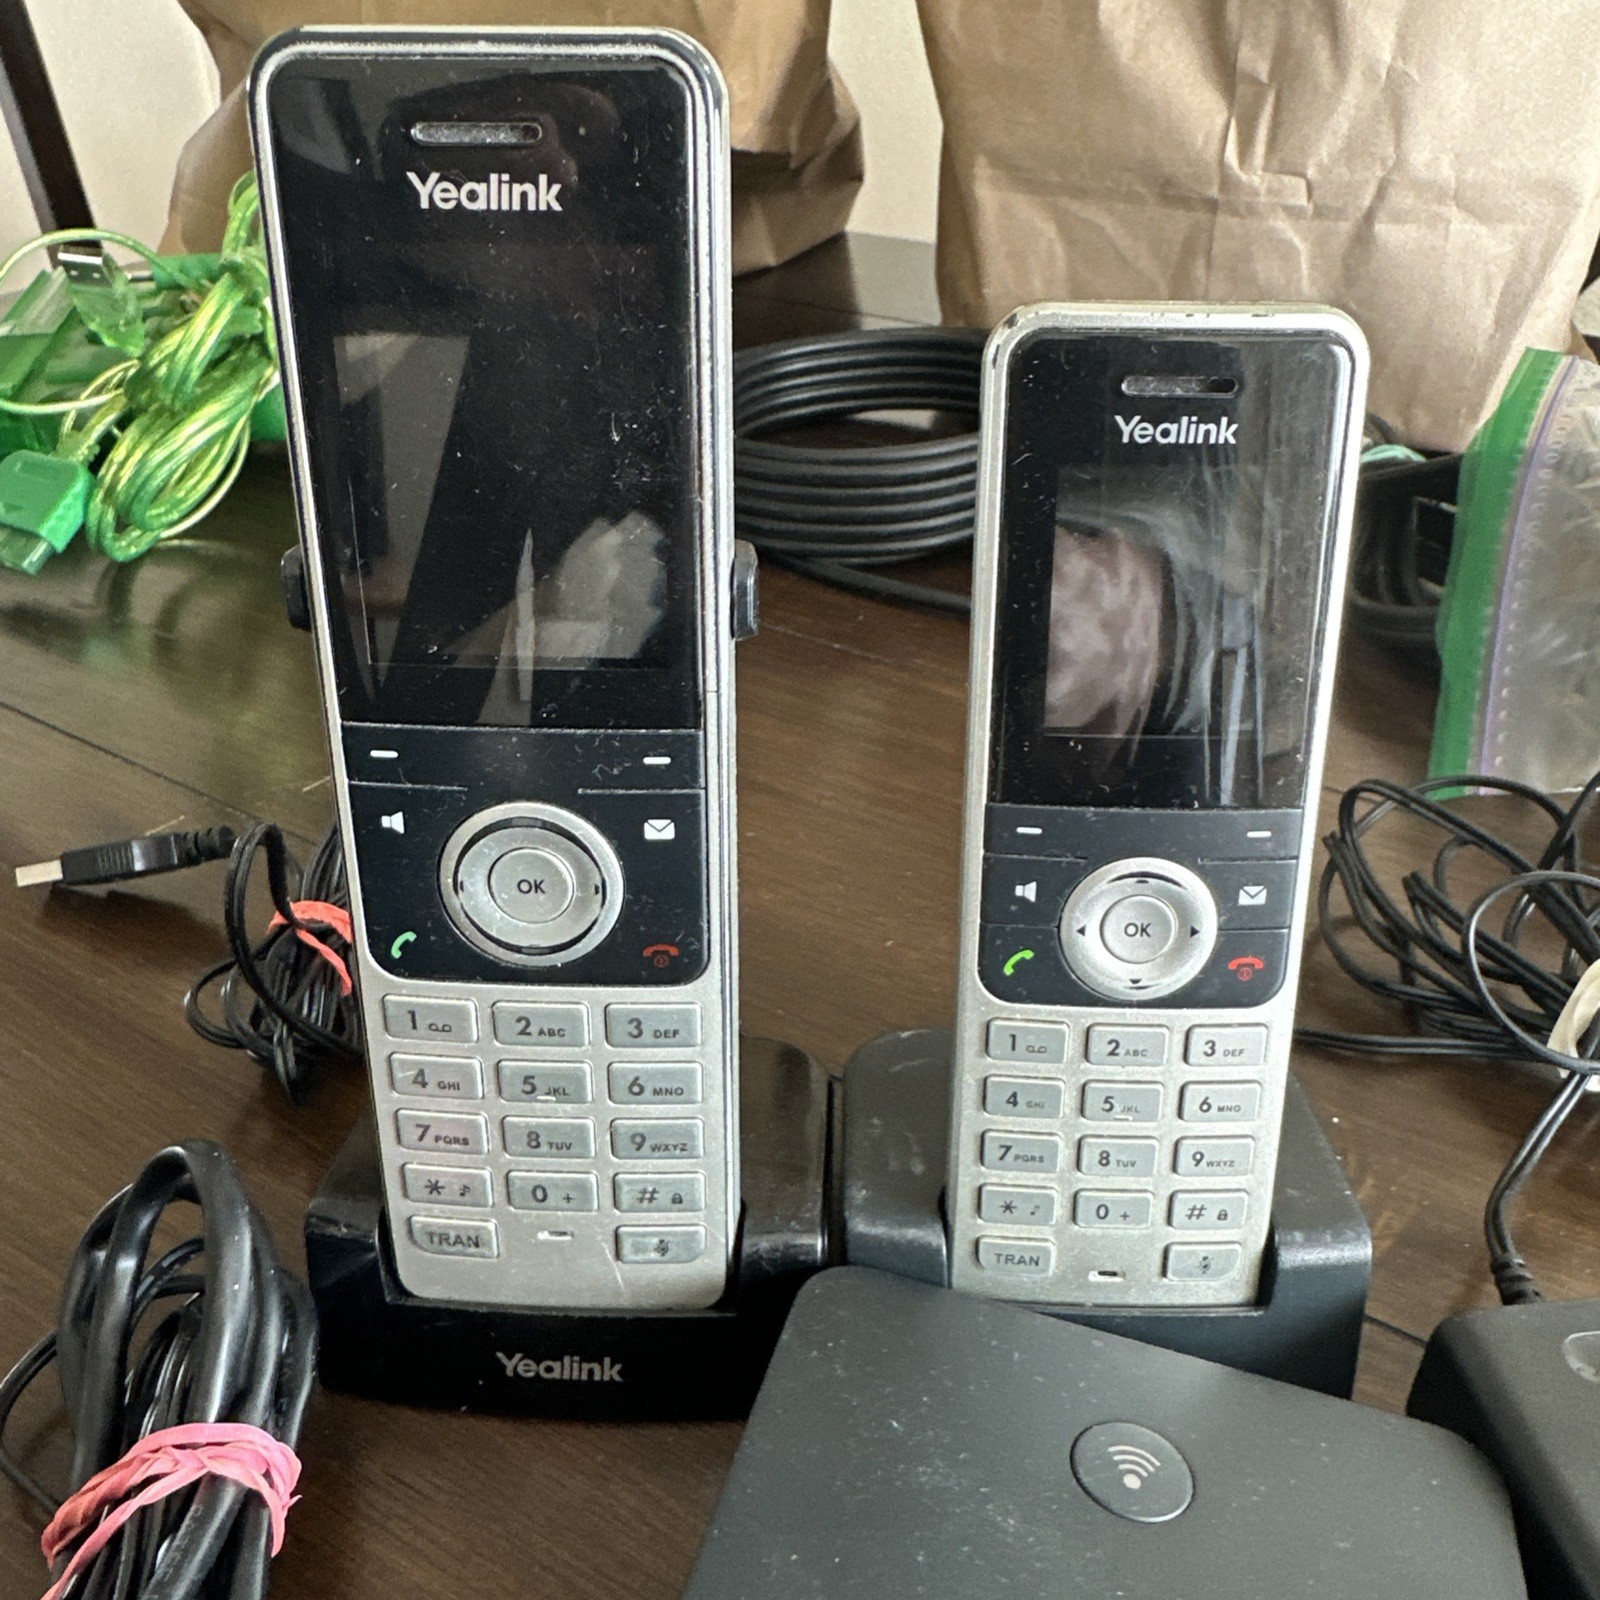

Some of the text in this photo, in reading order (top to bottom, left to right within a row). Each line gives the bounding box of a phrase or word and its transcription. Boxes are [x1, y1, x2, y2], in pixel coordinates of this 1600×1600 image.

[406, 171, 563, 211] Yealink
[1114, 415, 1239, 444] Yealink
[517, 879, 546, 895] OK
[1123, 922, 1152, 938] OK
[408, 1010, 418, 1031] 1
[516, 1016, 566, 1038] 2 ABC
[627, 1018, 680, 1038] 3 DEF
[1009, 1034, 1016, 1051] 1
[1106, 1039, 1148, 1057] 2 ABC
[1203, 1040, 1245, 1057] 3 DEF
[412, 1069, 461, 1091] 4 GHI
[521, 1075, 570, 1096] 5 JKL
[628, 1076, 684, 1096] 6 MNO
[1005, 1091, 1018, 1108] 4
[1102, 1096, 1140, 1113] 5 JKL
[1199, 1096, 1241, 1113] 6 MNO
[416, 1123, 470, 1146] 7 PQRS
[526, 1130, 572, 1151] 8 TUV
[630, 1132, 688, 1152] 9 WXYZ
[999, 1145, 1045, 1163] 7 PQRS
[1098, 1150, 1137, 1168] 8 TUV
[1192, 1151, 1235, 1168] 9 WXYZ
[532, 1185, 548, 1203] 0
[1096, 1204, 1109, 1220] 0
[427, 1231, 479, 1248] TRAN
[995, 1253, 1040, 1267] TRAN
[496, 1351, 623, 1382] Yealink
